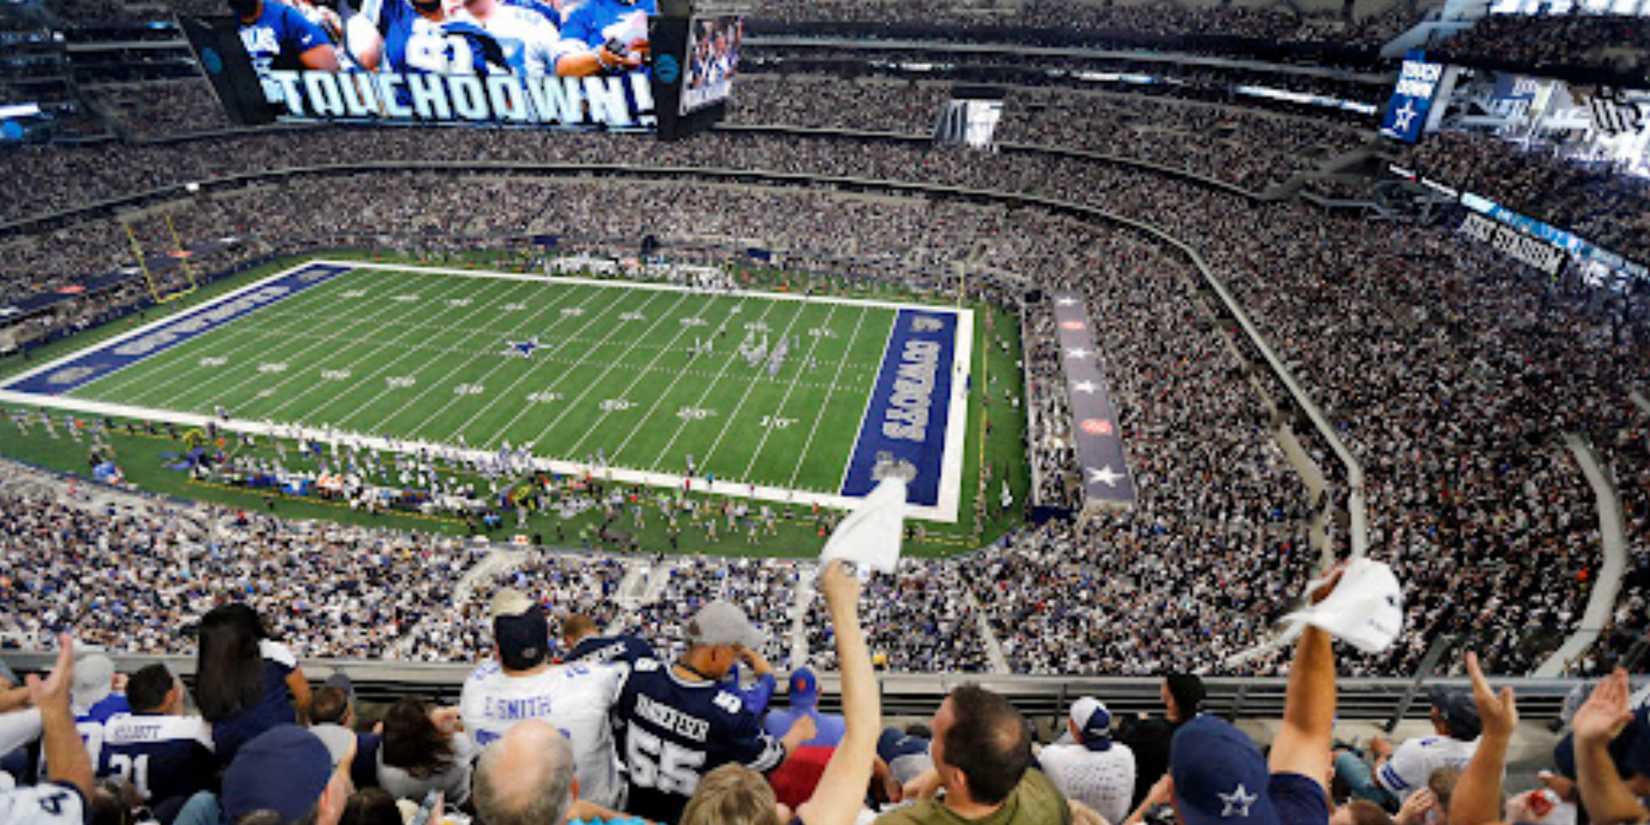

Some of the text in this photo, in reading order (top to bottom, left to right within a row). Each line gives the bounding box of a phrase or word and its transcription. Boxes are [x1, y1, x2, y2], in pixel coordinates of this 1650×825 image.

[1396, 79, 1436, 99] DOWN
[1399, 60, 1442, 81] TOUCH
[270, 69, 658, 127] TOUCHDOWN!
[1492, 223, 1565, 275] STADIUM
[882, 340, 942, 443] COWBOYS
[497, 696, 552, 720] SMITH
[108, 752, 152, 798] 21
[626, 718, 708, 797] 55
